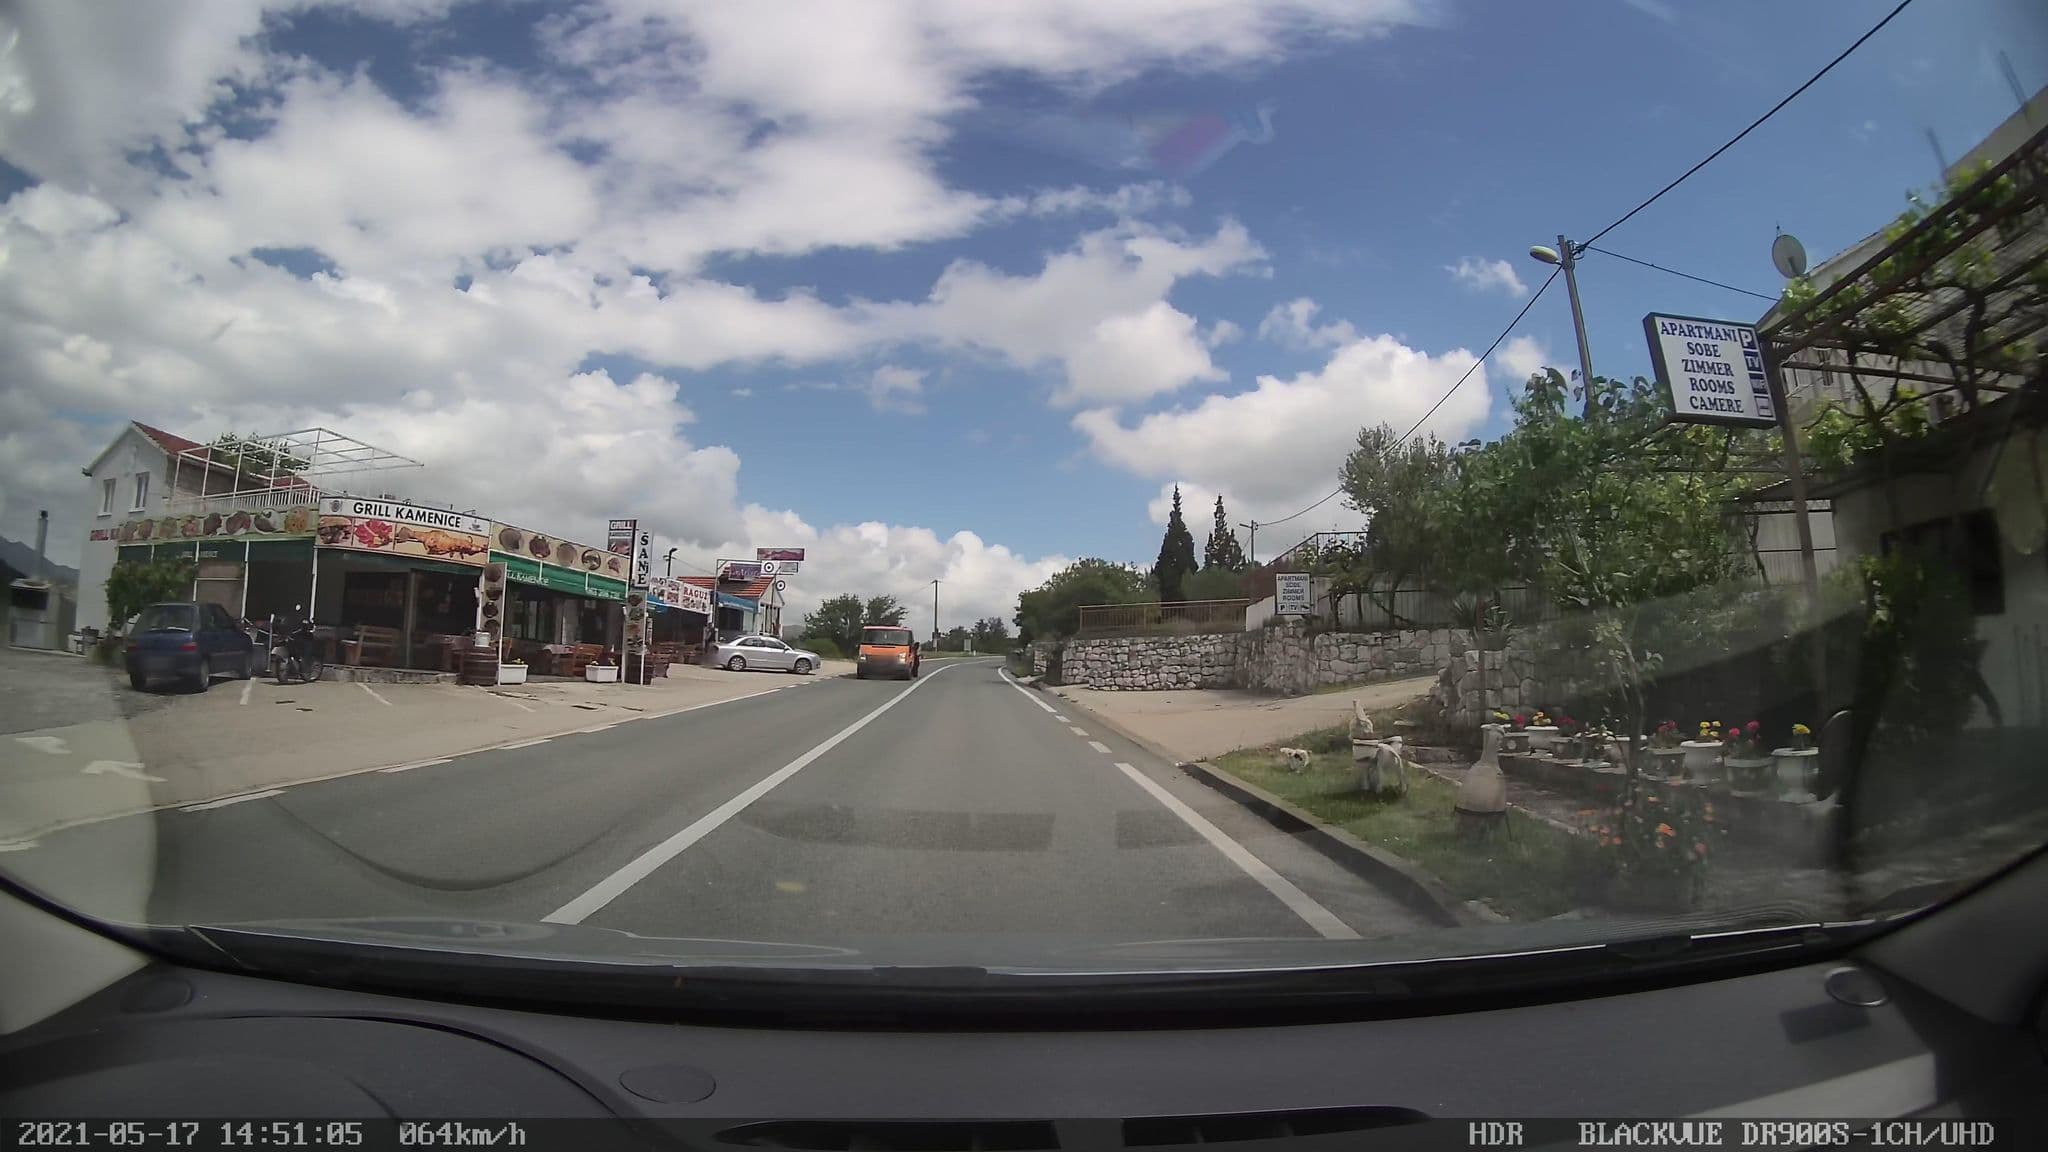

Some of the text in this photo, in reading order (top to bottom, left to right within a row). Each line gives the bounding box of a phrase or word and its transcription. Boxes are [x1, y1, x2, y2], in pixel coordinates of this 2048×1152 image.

[1660, 321, 1738, 342] APARTMANI
[1686, 341, 1721, 358] SOBE
[1681, 359, 1734, 376] ZIMMER
[1689, 377, 1735, 394] ROOMS
[1689, 396, 1744, 413] CAMERE
[353, 501, 462, 528] GRILL KAMENICE
[610, 520, 632, 529] GRILL
